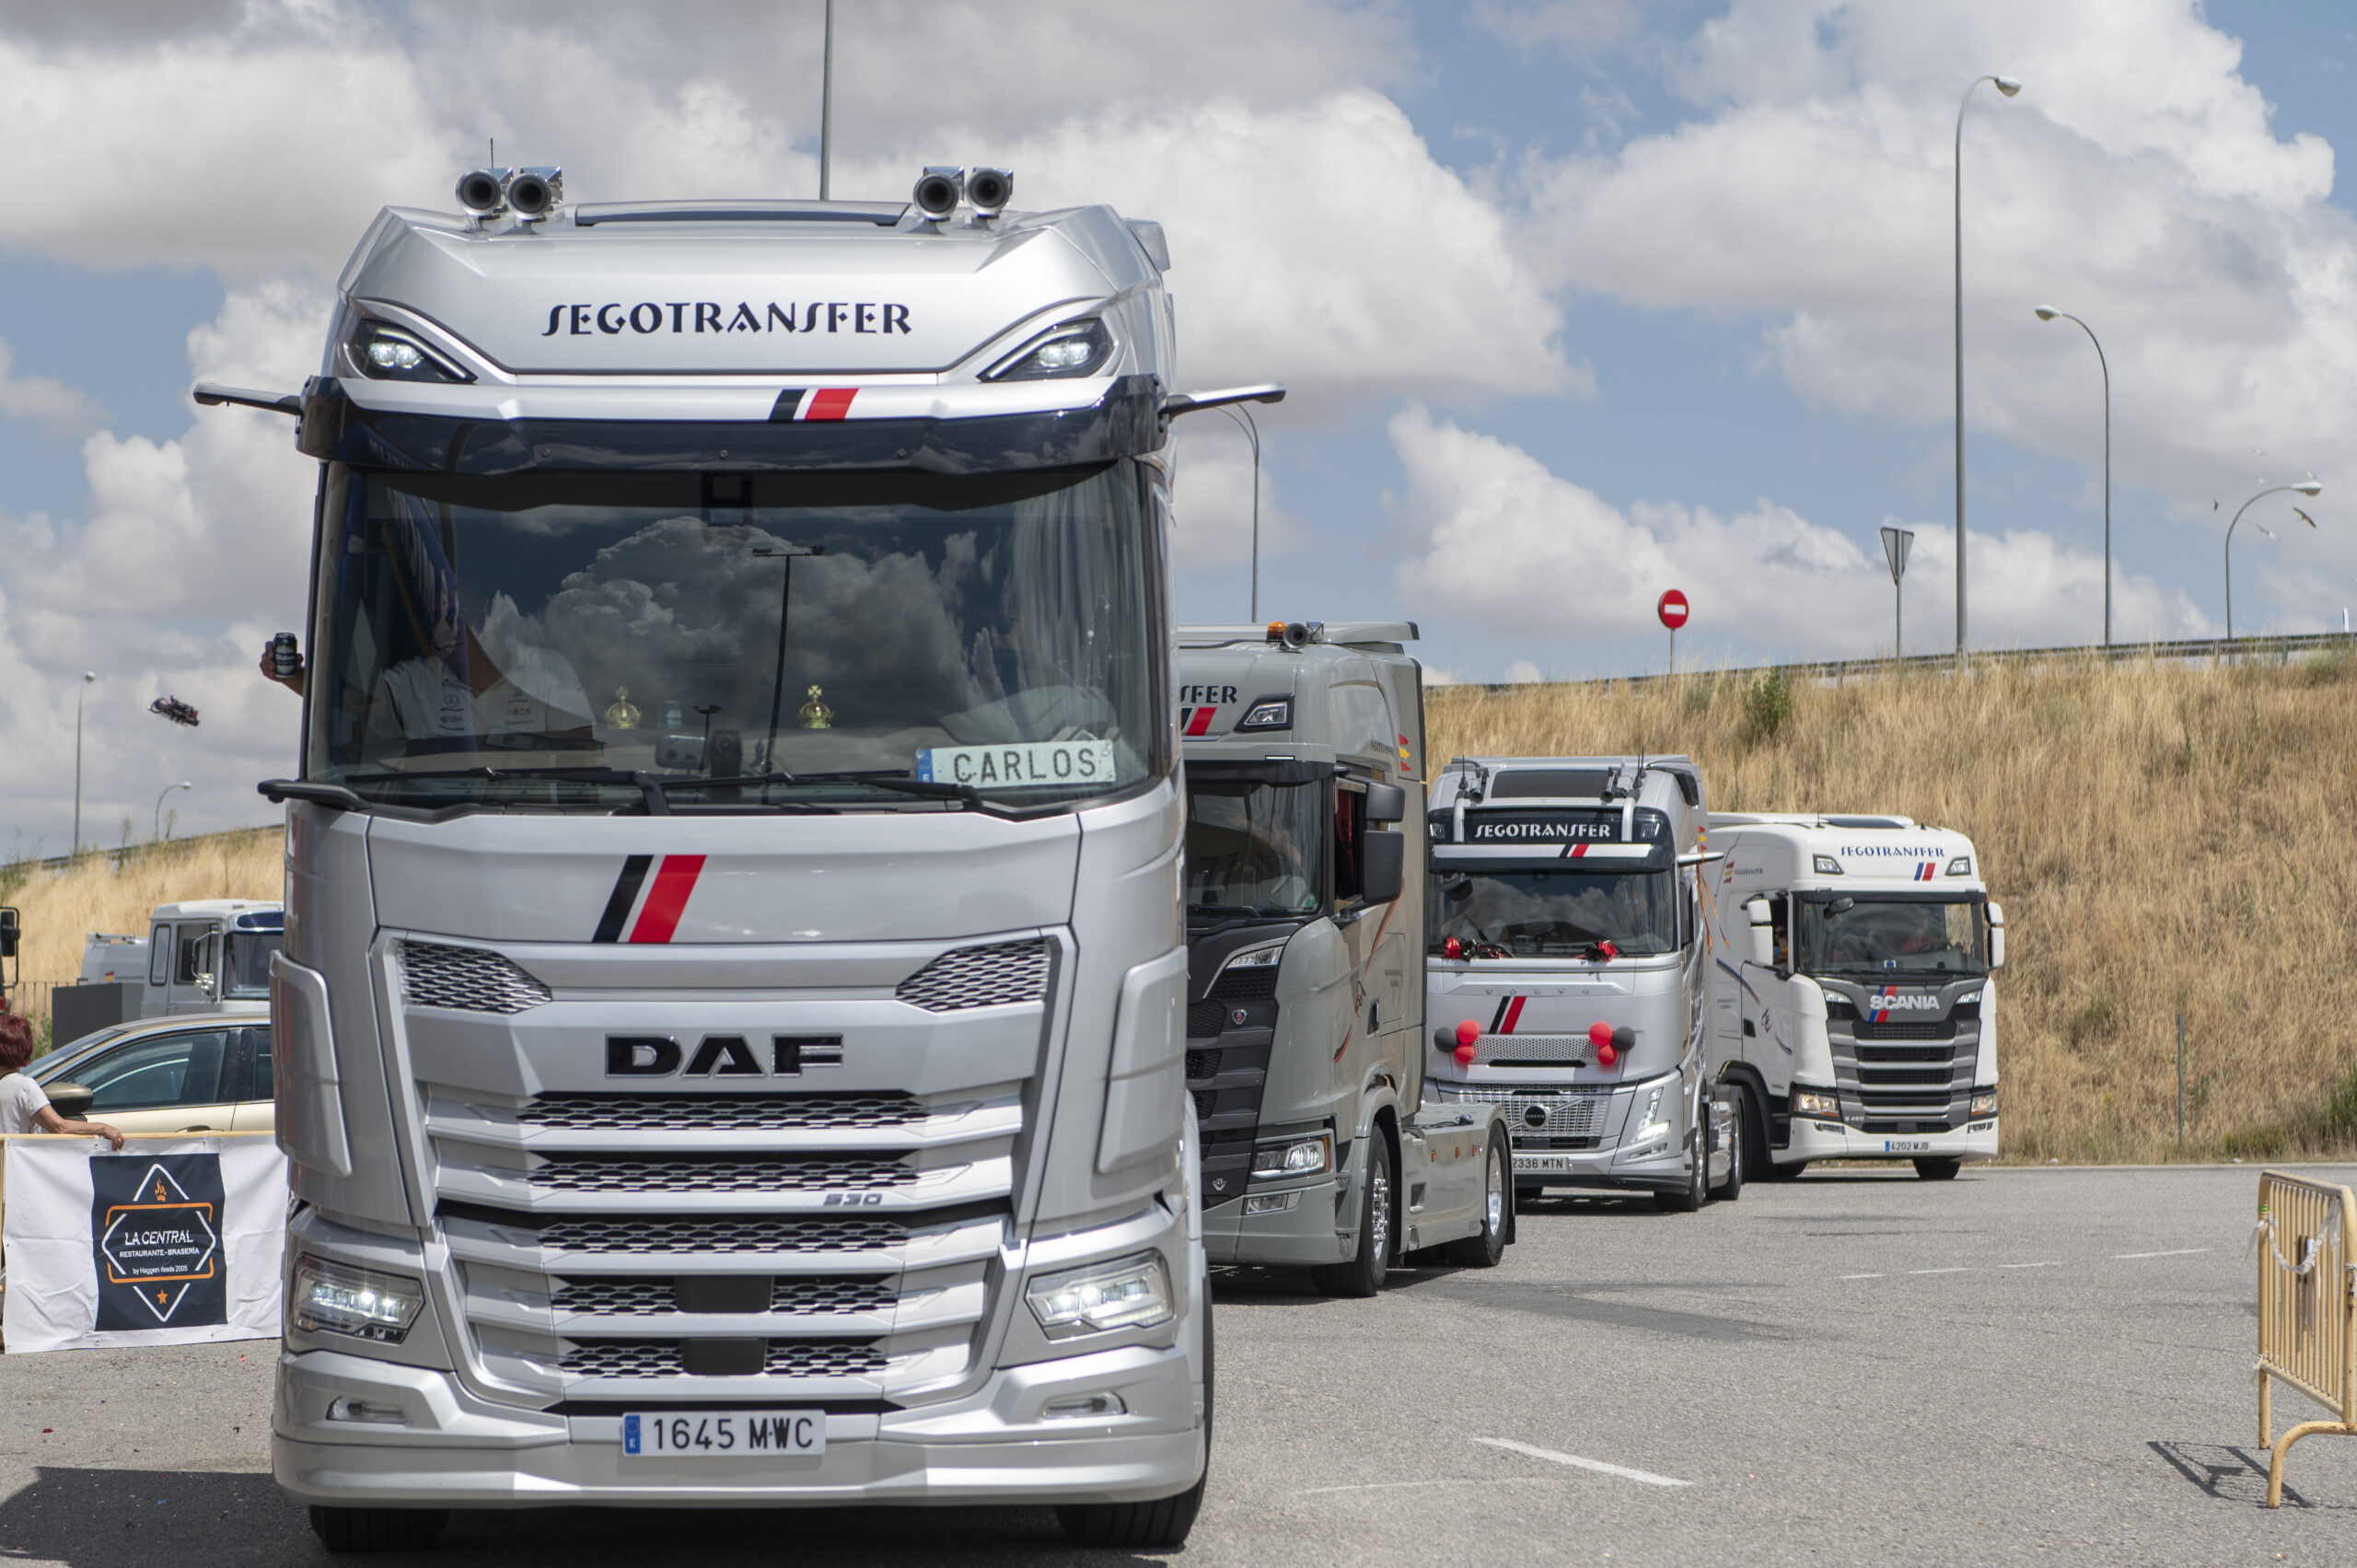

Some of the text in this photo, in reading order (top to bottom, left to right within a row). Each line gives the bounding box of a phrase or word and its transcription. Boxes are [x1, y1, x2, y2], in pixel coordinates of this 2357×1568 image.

[541, 301, 912, 337] SEGOTRANSFER
[954, 748, 1097, 783] CARLOS
[1475, 824, 1610, 838] SEGOTRANSFER
[1840, 846, 1945, 857] SEGOTRANSFER
[1869, 995, 1941, 1010] SCANIA
[605, 1033, 844, 1078] DAF
[1891, 1142, 1911, 1151] 4202
[1513, 1158, 1563, 1169] 2336 MTN
[823, 1193, 884, 1206] 530
[124, 1230, 194, 1246] LA CENTRAL
[160, 1265, 175, 1273] desde
[175, 1264, 189, 1272] 2005
[654, 1417, 814, 1450] 1645 MWC
